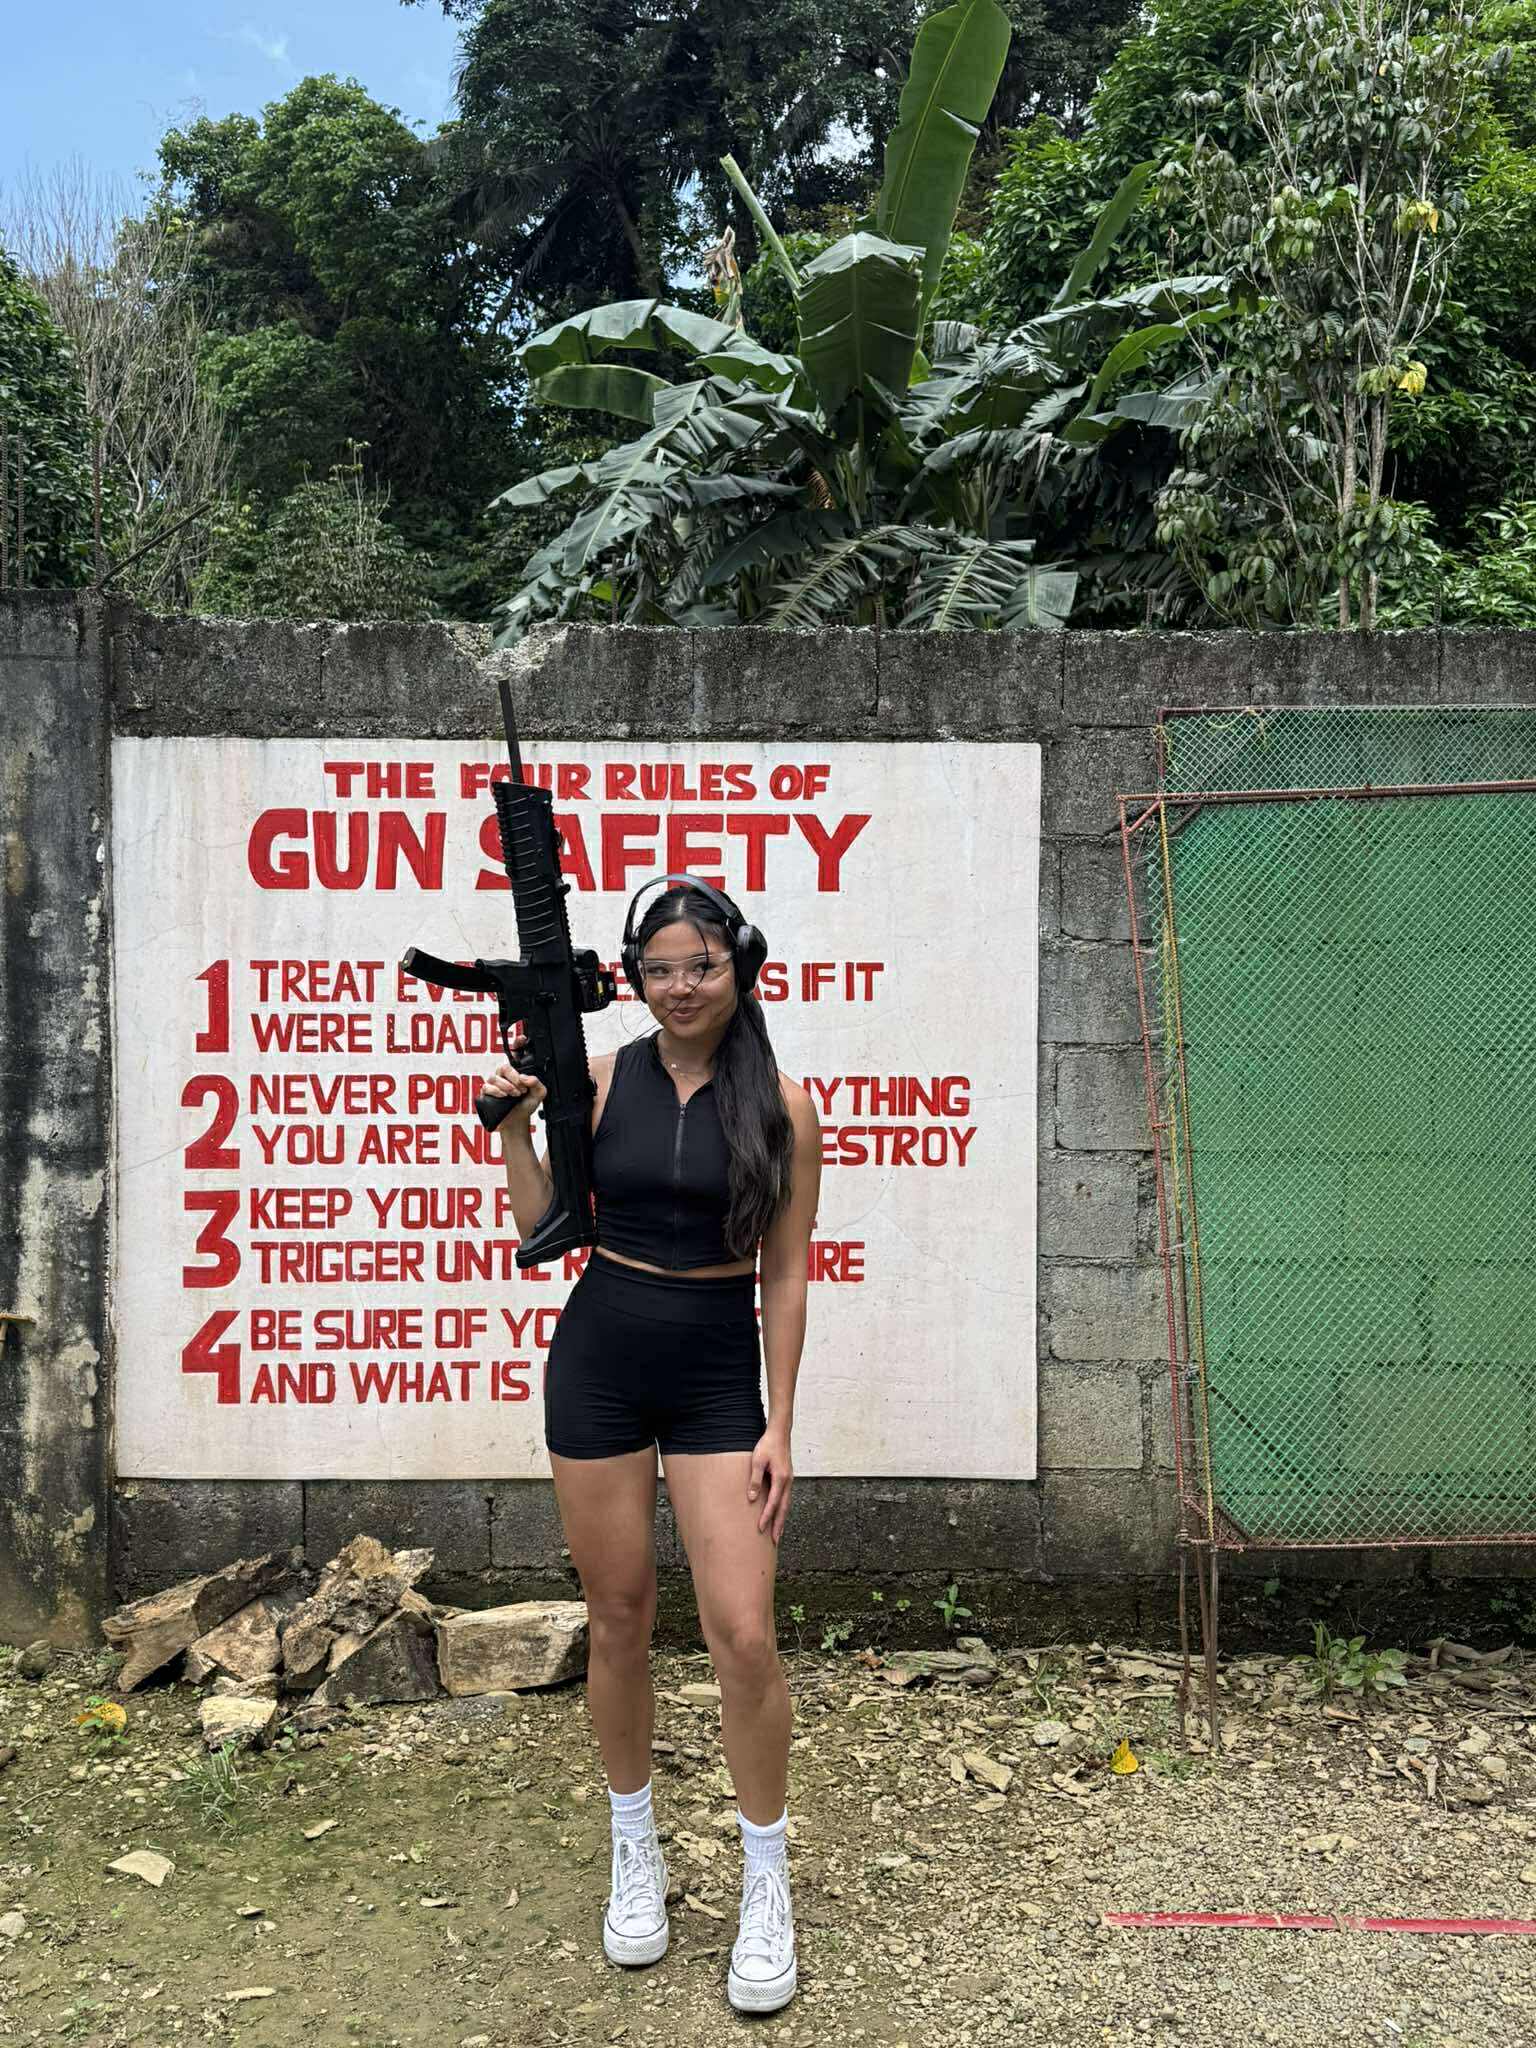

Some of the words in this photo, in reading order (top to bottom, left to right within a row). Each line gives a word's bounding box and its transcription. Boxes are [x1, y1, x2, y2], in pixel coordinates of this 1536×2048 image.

[324, 762, 434, 799] THE
[604, 764, 756, 801] RULES
[769, 764, 830, 800] OF
[248, 809, 446, 891] GUN
[249, 960, 384, 1003] TREAT
[753, 962, 788, 1002] S
[801, 963, 834, 1001] IF
[845, 962, 883, 1001] IT
[195, 960, 229, 1053] 1
[251, 1014, 371, 1053] WERE
[386, 1014, 523, 1054] LOADE
[250, 1074, 395, 1115] NEVER
[408, 1074, 482, 1115] POI
[803, 1077, 969, 1117] YTHING
[181, 1075, 240, 1170] 2
[252, 1125, 345, 1165] YOU
[358, 1124, 439, 1165] ARE
[451, 1124, 536, 1166] NO
[819, 1126, 976, 1167] ESTROY
[249, 1188, 352, 1230] KEEP
[367, 1187, 481, 1230] YOUR
[182, 1191, 240, 1289] 3
[251, 1241, 424, 1284] TRIGGER
[808, 1241, 864, 1283] IRE
[250, 1310, 301, 1351] BE
[313, 1308, 421, 1350] SURE
[434, 1308, 486, 1349] OF
[181, 1311, 240, 1405] 4
[250, 1363, 336, 1404] AND
[349, 1361, 479, 1403] WHAT
[491, 1361, 529, 1402] IS
